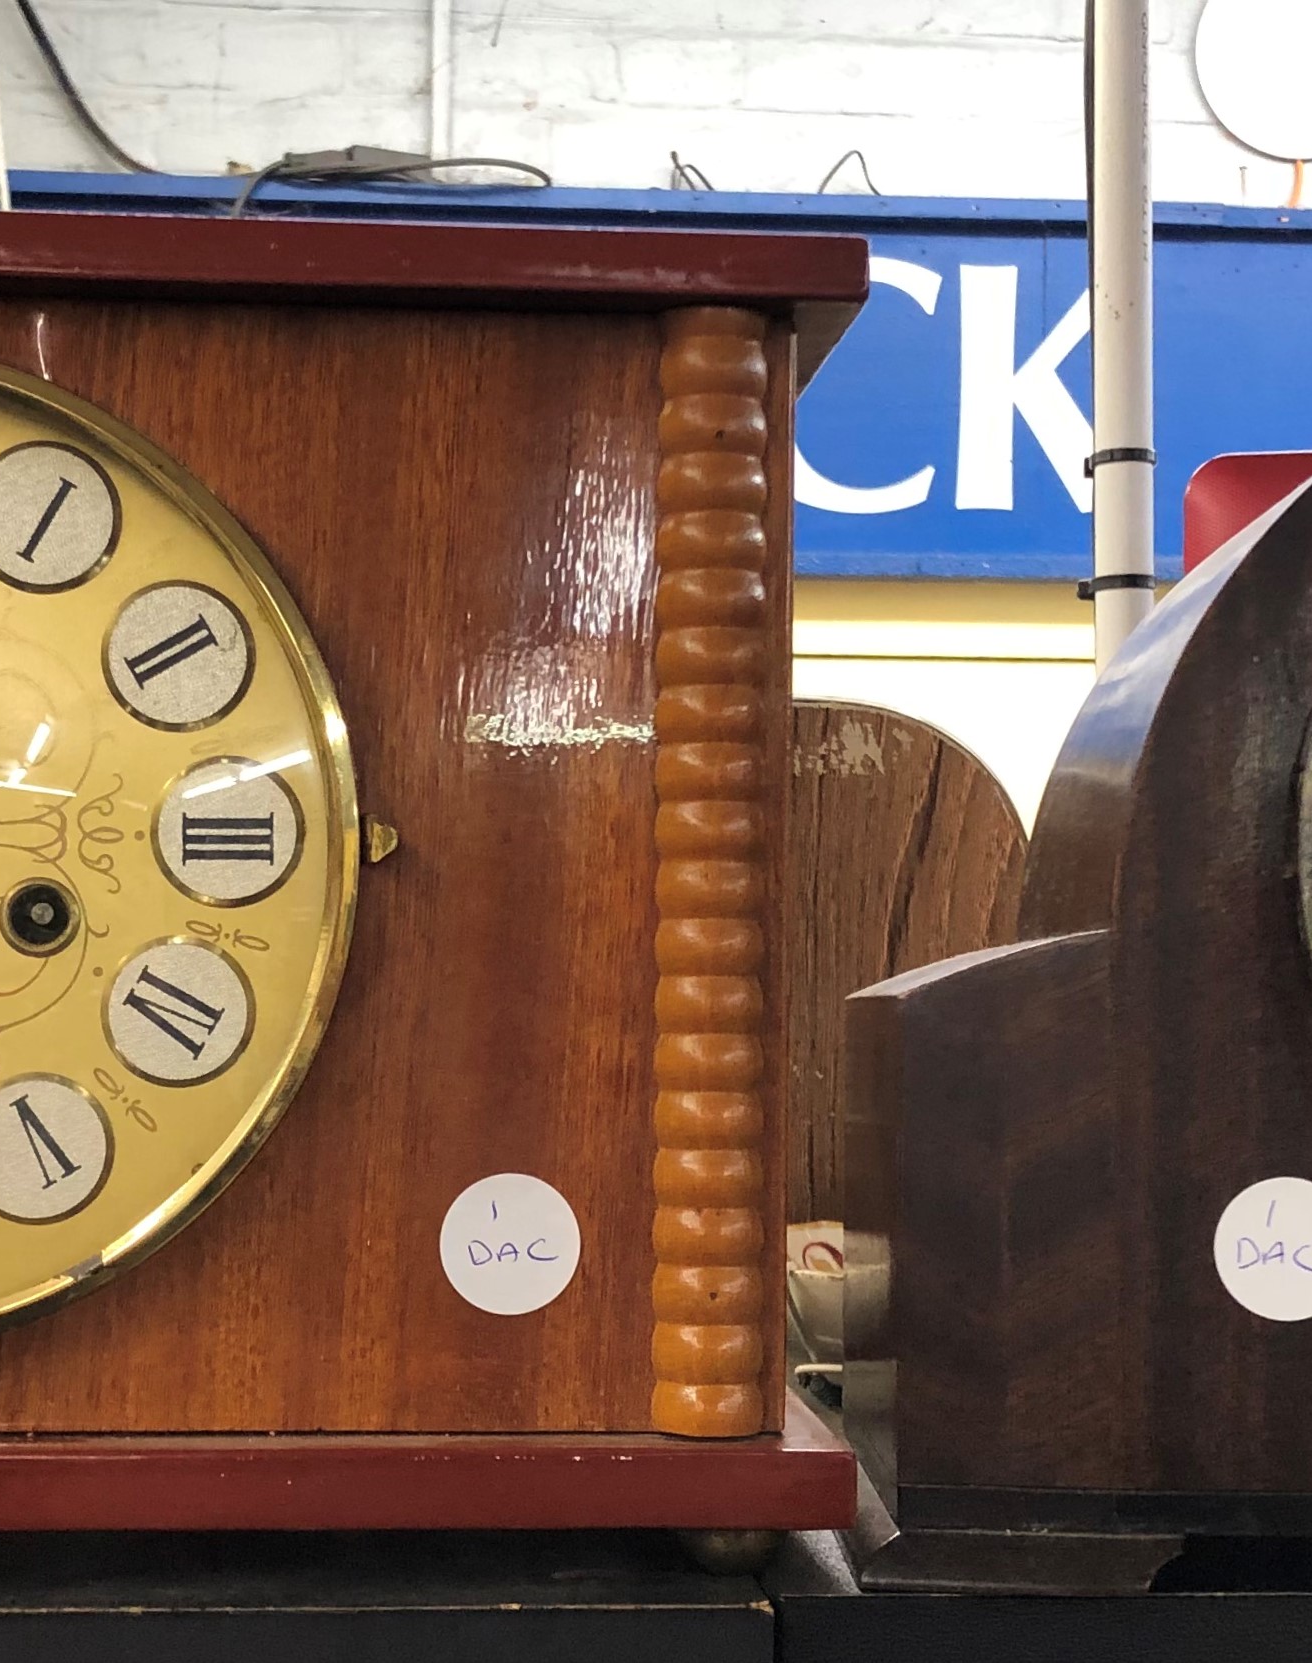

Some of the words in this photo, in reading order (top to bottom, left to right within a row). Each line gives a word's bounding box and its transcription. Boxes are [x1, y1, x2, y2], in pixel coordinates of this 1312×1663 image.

[17, 477, 77, 563] I
[124, 614, 217, 690] II
[182, 812, 274, 866] III
[122, 965, 224, 1060] IV
[9, 1094, 81, 1189] V
[468, 1238, 559, 1265] DAC
